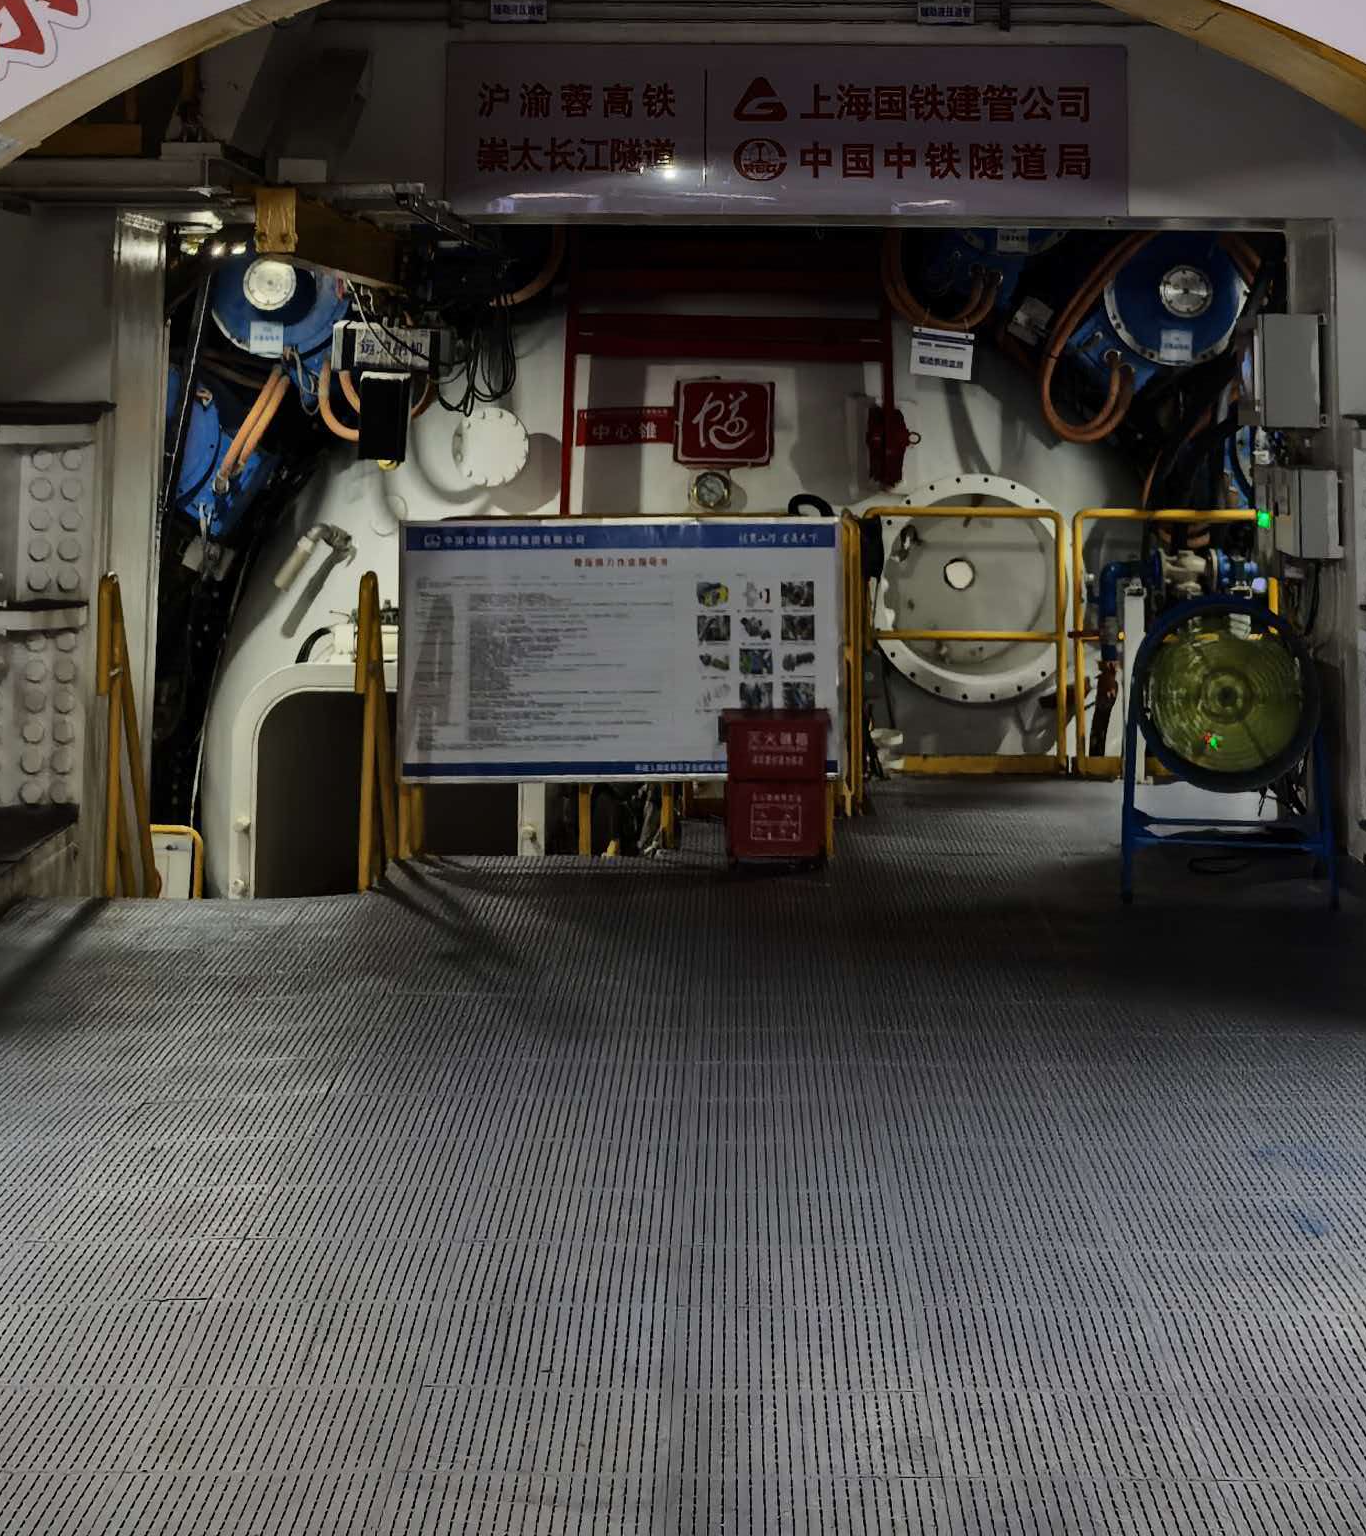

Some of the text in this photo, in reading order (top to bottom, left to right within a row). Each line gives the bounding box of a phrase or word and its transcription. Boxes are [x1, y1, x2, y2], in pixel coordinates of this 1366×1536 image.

[477, 82, 676, 119] 沪渝蓉高铁
[799, 83, 1091, 123] 上海国铁建管公司
[476, 137, 676, 174] 崇太长江隧道
[799, 141, 1092, 181] 中国中铁隧道局
